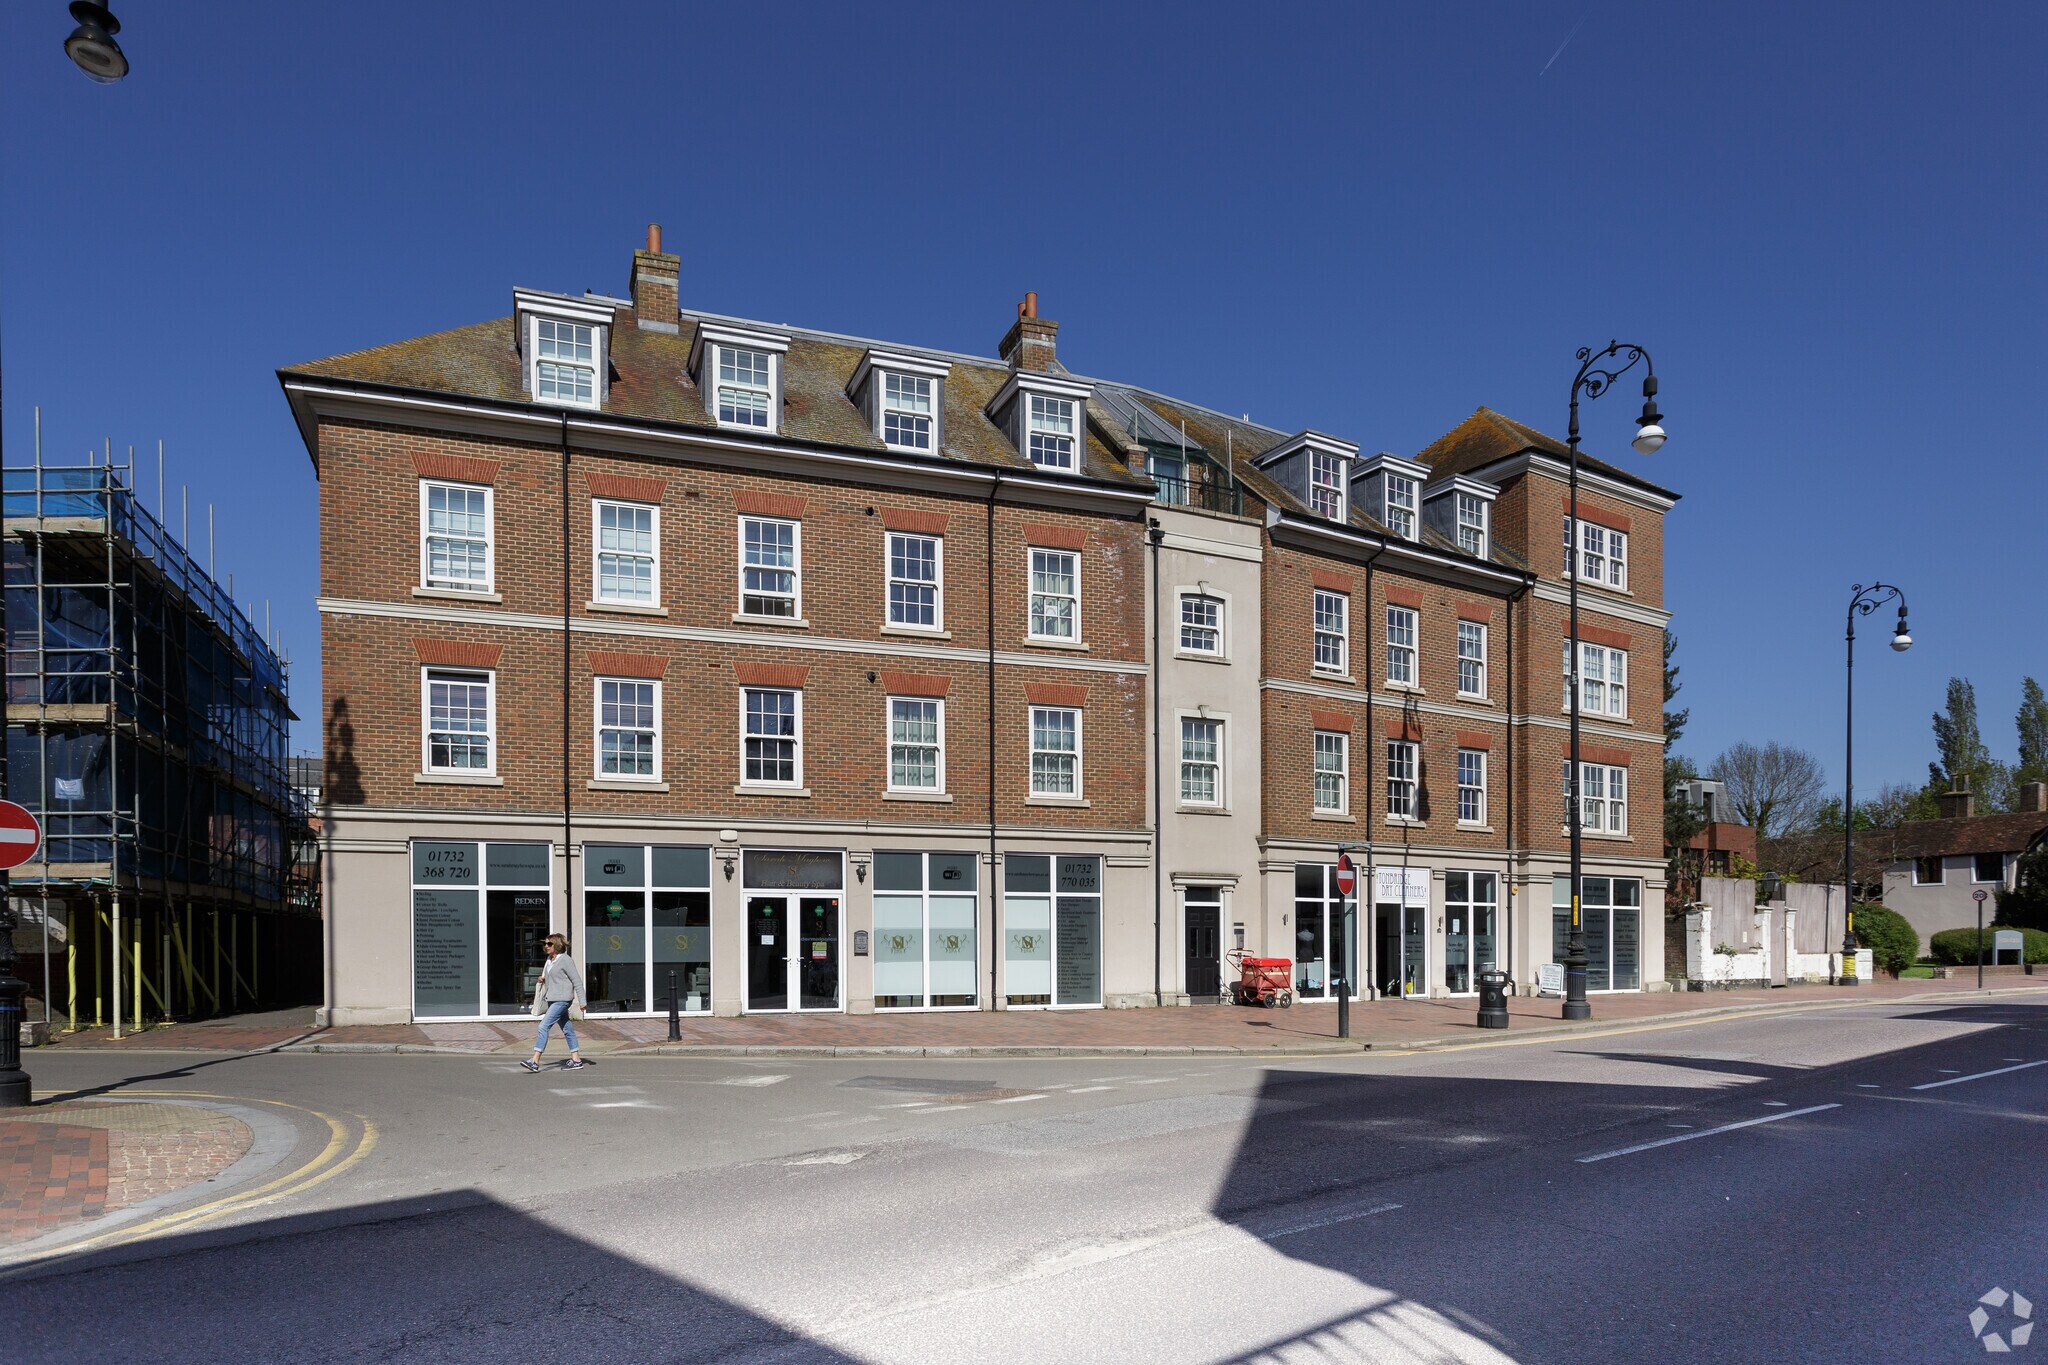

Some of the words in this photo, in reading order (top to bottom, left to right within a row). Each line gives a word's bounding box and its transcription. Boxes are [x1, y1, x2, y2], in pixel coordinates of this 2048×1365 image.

[428, 851, 465, 862] 01732
[422, 867, 445, 878] 368
[449, 867, 470, 879] 720
[1065, 864, 1092, 873] 01732
[1061, 878, 1077, 887] 770
[1079, 878, 1095, 887] 035
[1379, 872, 1411, 885] TONBRIDGE
[1382, 885, 1393, 896] DRY
